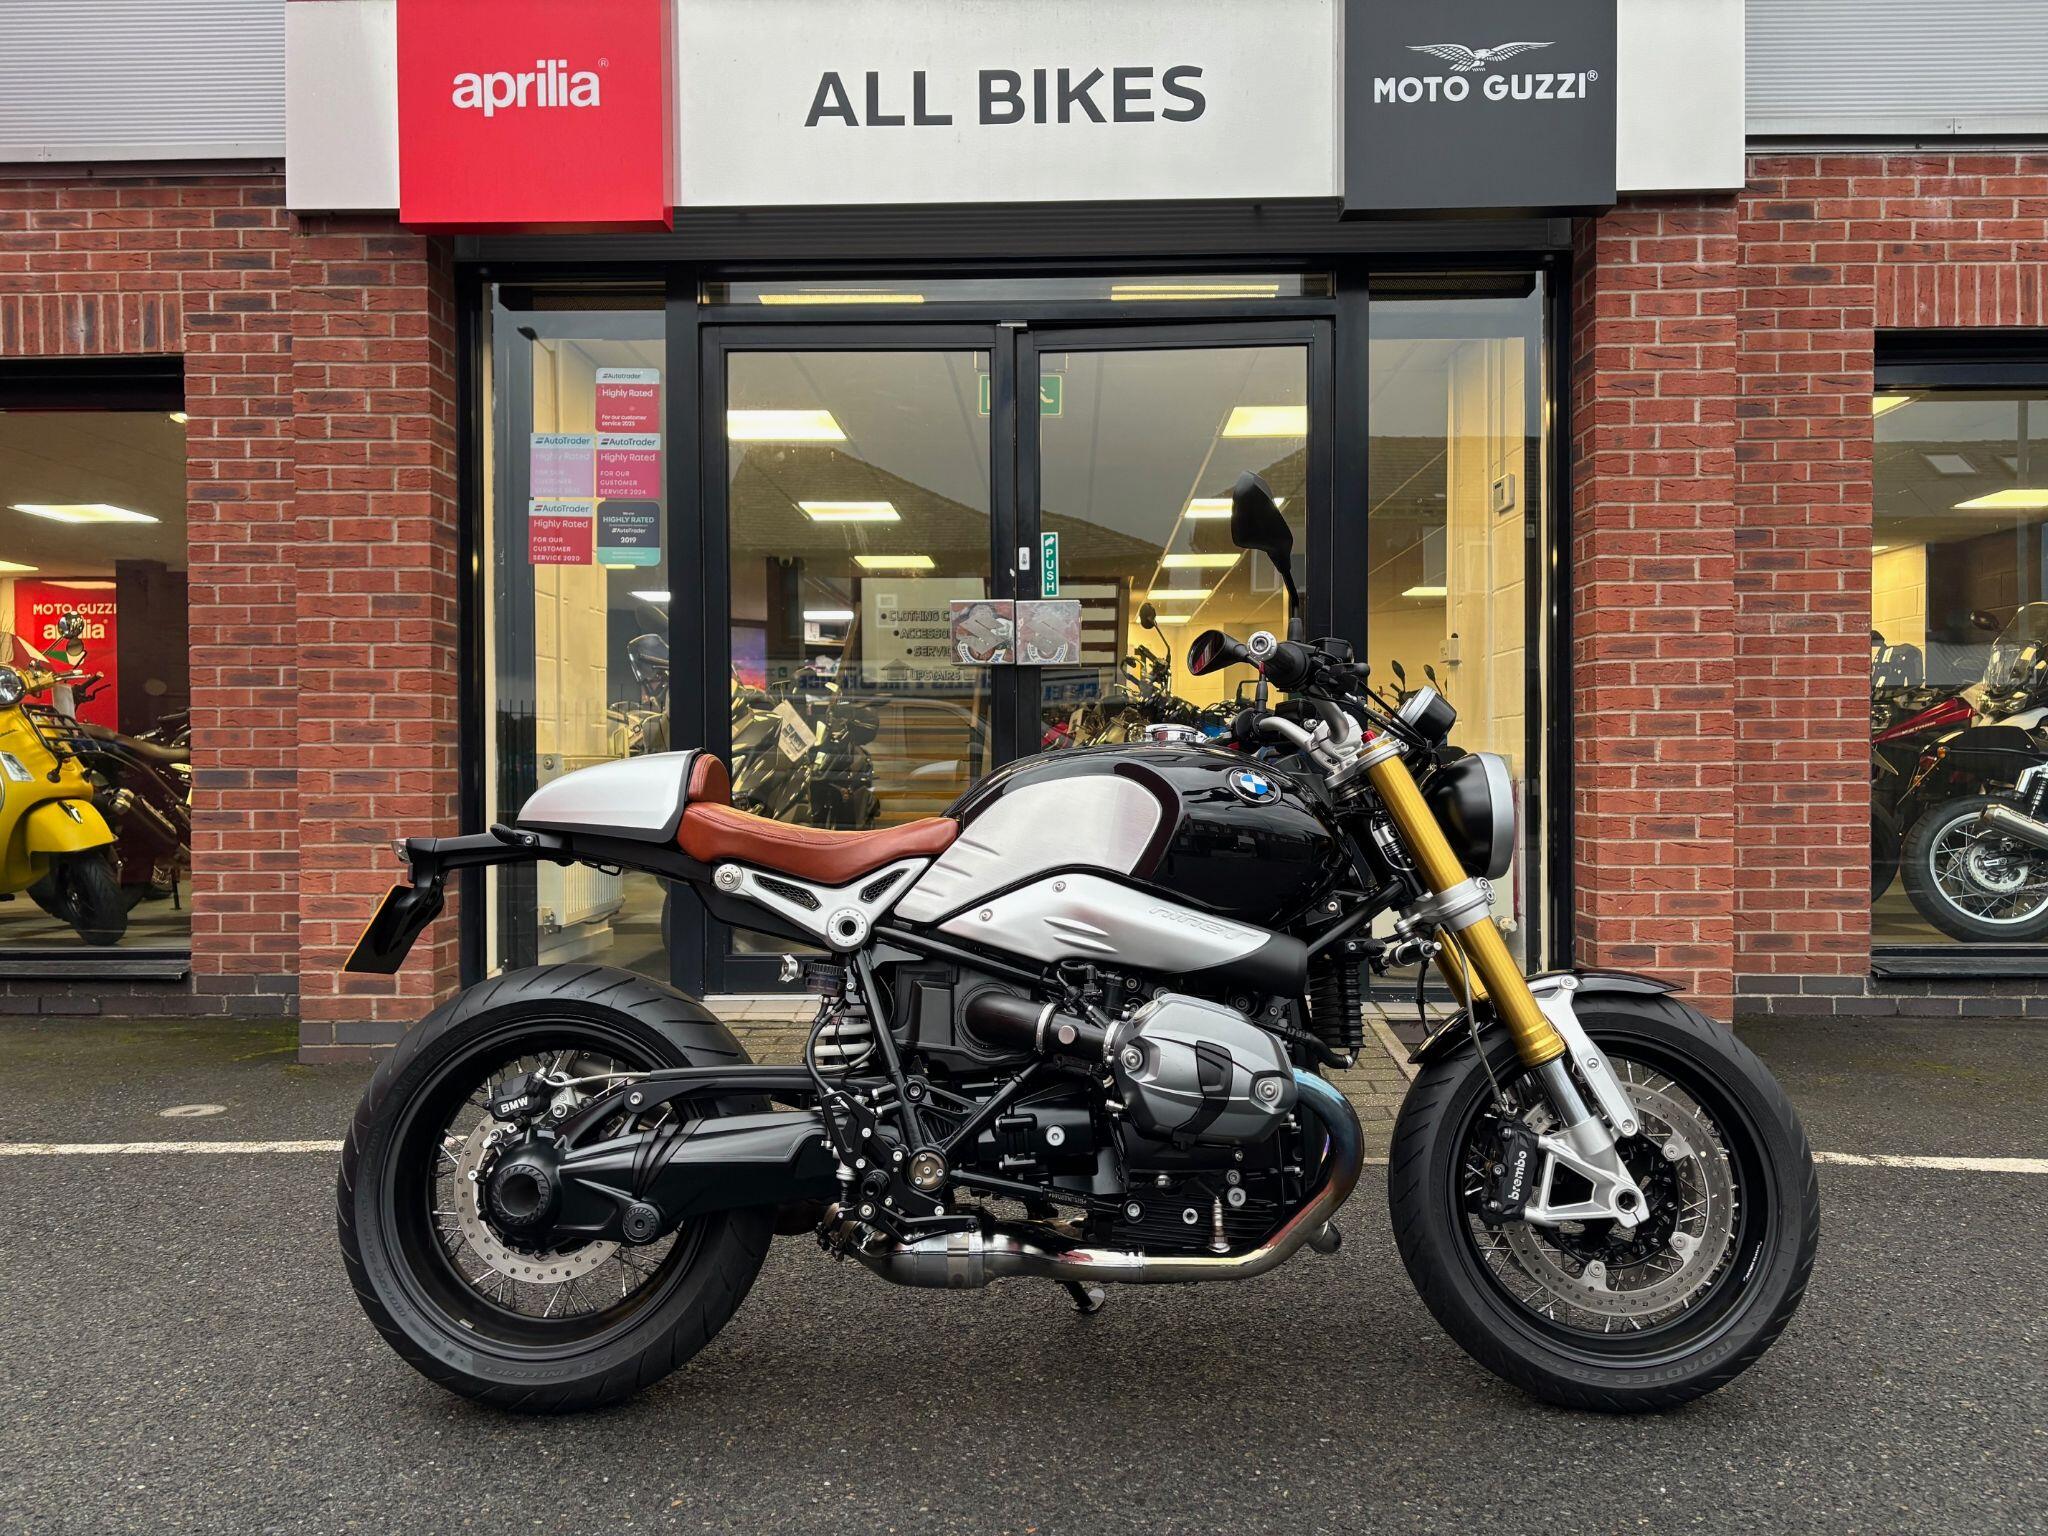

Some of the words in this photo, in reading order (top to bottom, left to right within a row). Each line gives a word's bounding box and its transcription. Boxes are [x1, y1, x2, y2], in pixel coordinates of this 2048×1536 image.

[452, 59, 600, 117] aprilia
[1374, 75, 1470, 103] MOTO
[1483, 72, 1586, 101] GUZZI
[804, 70, 953, 127] ALL
[979, 65, 1207, 125] BIKES
[602, 389, 628, 399] Highly
[629, 389, 653, 397] Rated
[544, 437, 591, 445] AutoTrader
[609, 438, 656, 446] AutoTrader
[600, 453, 628, 463] Highly
[629, 453, 656, 461] Rated
[543, 504, 590, 513] AutoTrader
[533, 519, 561, 529] Highly
[562, 520, 588, 528] Rated
[620, 536, 637, 544] 2019
[1045, 548, 1055, 592] PUSH
[33, 603, 73, 615] MOTO
[76, 602, 117, 615] GUZZI
[889, 610, 940, 621] CLOTHING
[900, 628, 951, 639] ACCESSO
[910, 669, 961, 681] UPSTAIRS
[500, 1096, 528, 1113] BMW
[1507, 1150, 1528, 1200] brembo
